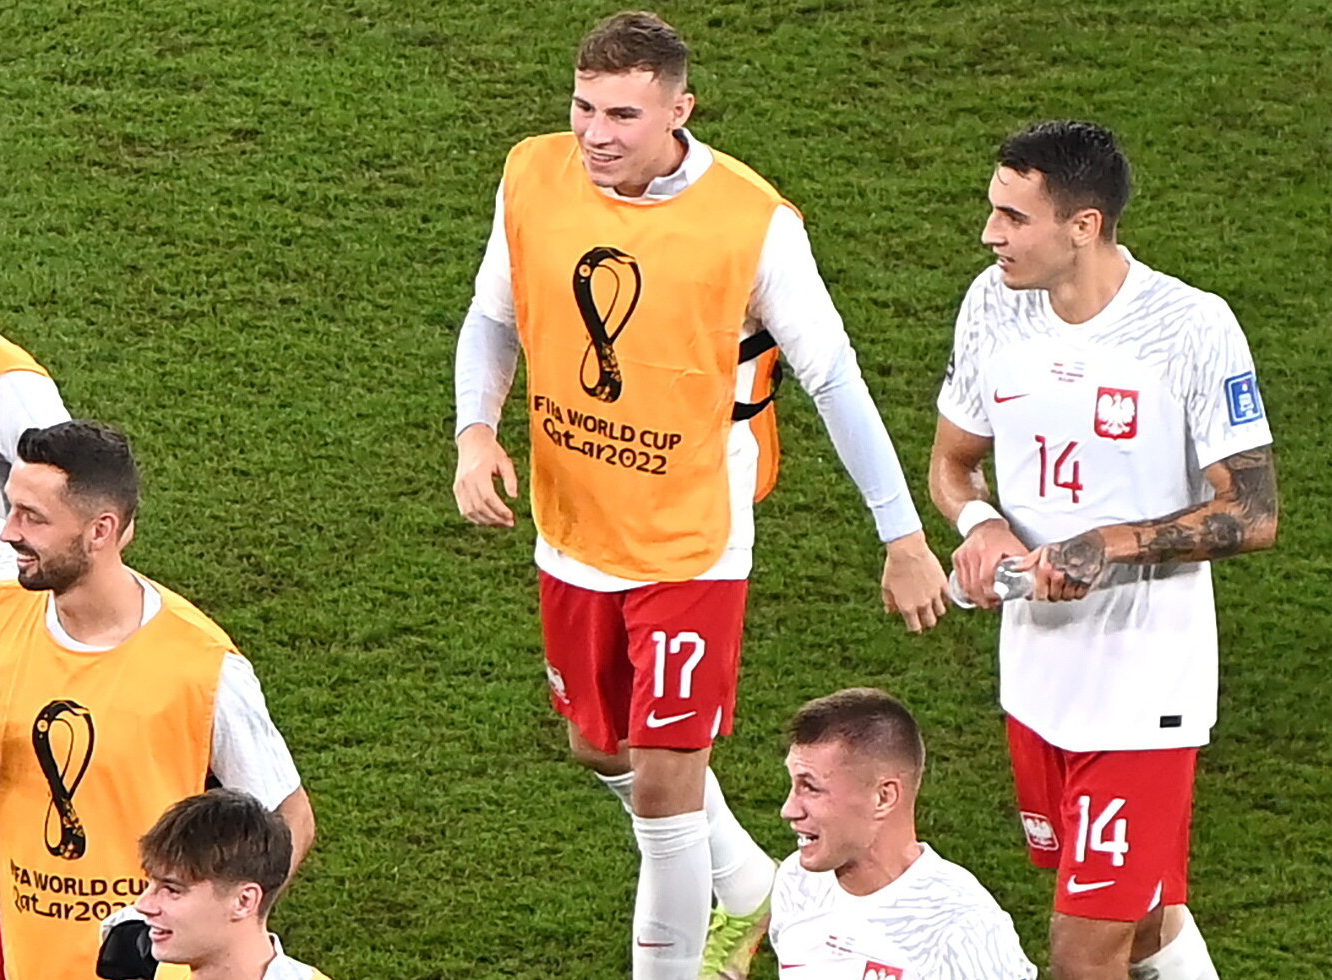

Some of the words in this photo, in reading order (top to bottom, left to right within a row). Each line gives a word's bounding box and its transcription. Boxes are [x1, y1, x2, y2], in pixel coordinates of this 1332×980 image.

[567, 408, 635, 442] WORLD
[640, 430, 682, 450] CUP
[1034, 434, 1083, 504] 14
[652, 630, 706, 699] 17
[1075, 795, 1130, 867] 14
[33, 870, 108, 896] WORLD
